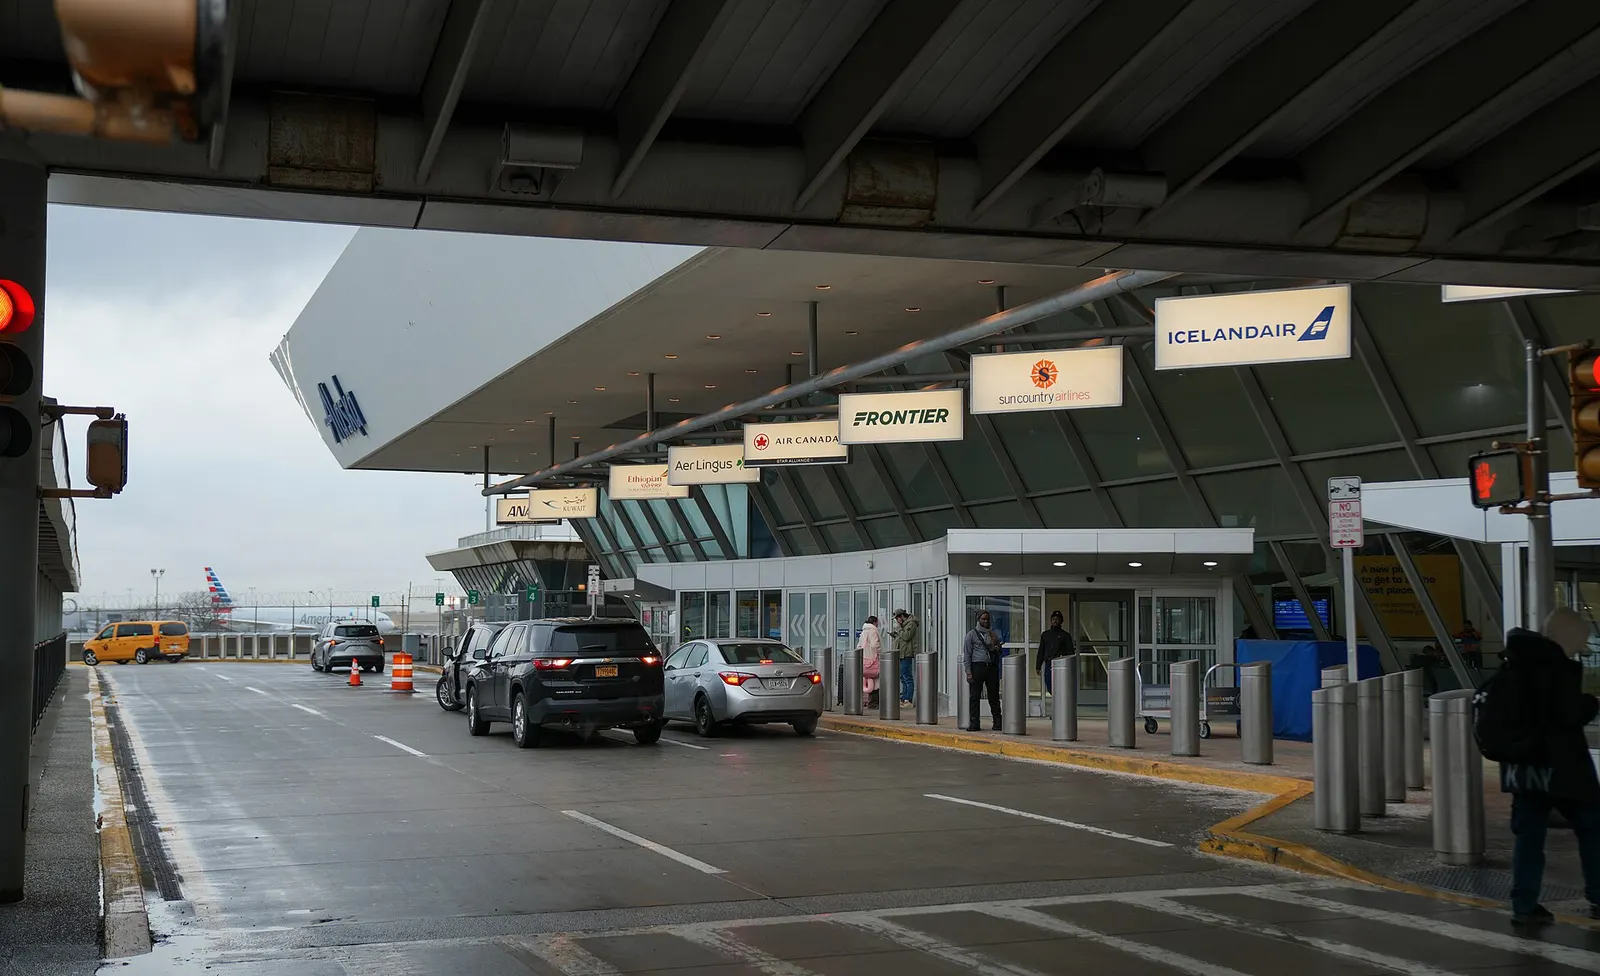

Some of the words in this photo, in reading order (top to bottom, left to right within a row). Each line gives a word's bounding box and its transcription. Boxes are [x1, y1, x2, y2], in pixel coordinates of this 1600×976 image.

[1168, 323, 1297, 345] ICELANDAIR
[1038, 367, 1051, 382] S
[1055, 389, 1091, 402] airlines
[852, 408, 950, 427] FRONTIER
[775, 437, 793, 445] AIR
[795, 435, 839, 445] CANADA
[674, 460, 695, 471] Aer
[696, 459, 733, 473] Lingus
[627, 475, 663, 485] Ethiopian
[1339, 502, 1352, 511] NO
[1361, 565, 1368, 574] A
[1374, 577, 1390, 586] get
[471, 595, 477, 603] 3
[528, 592, 535, 601] 4
